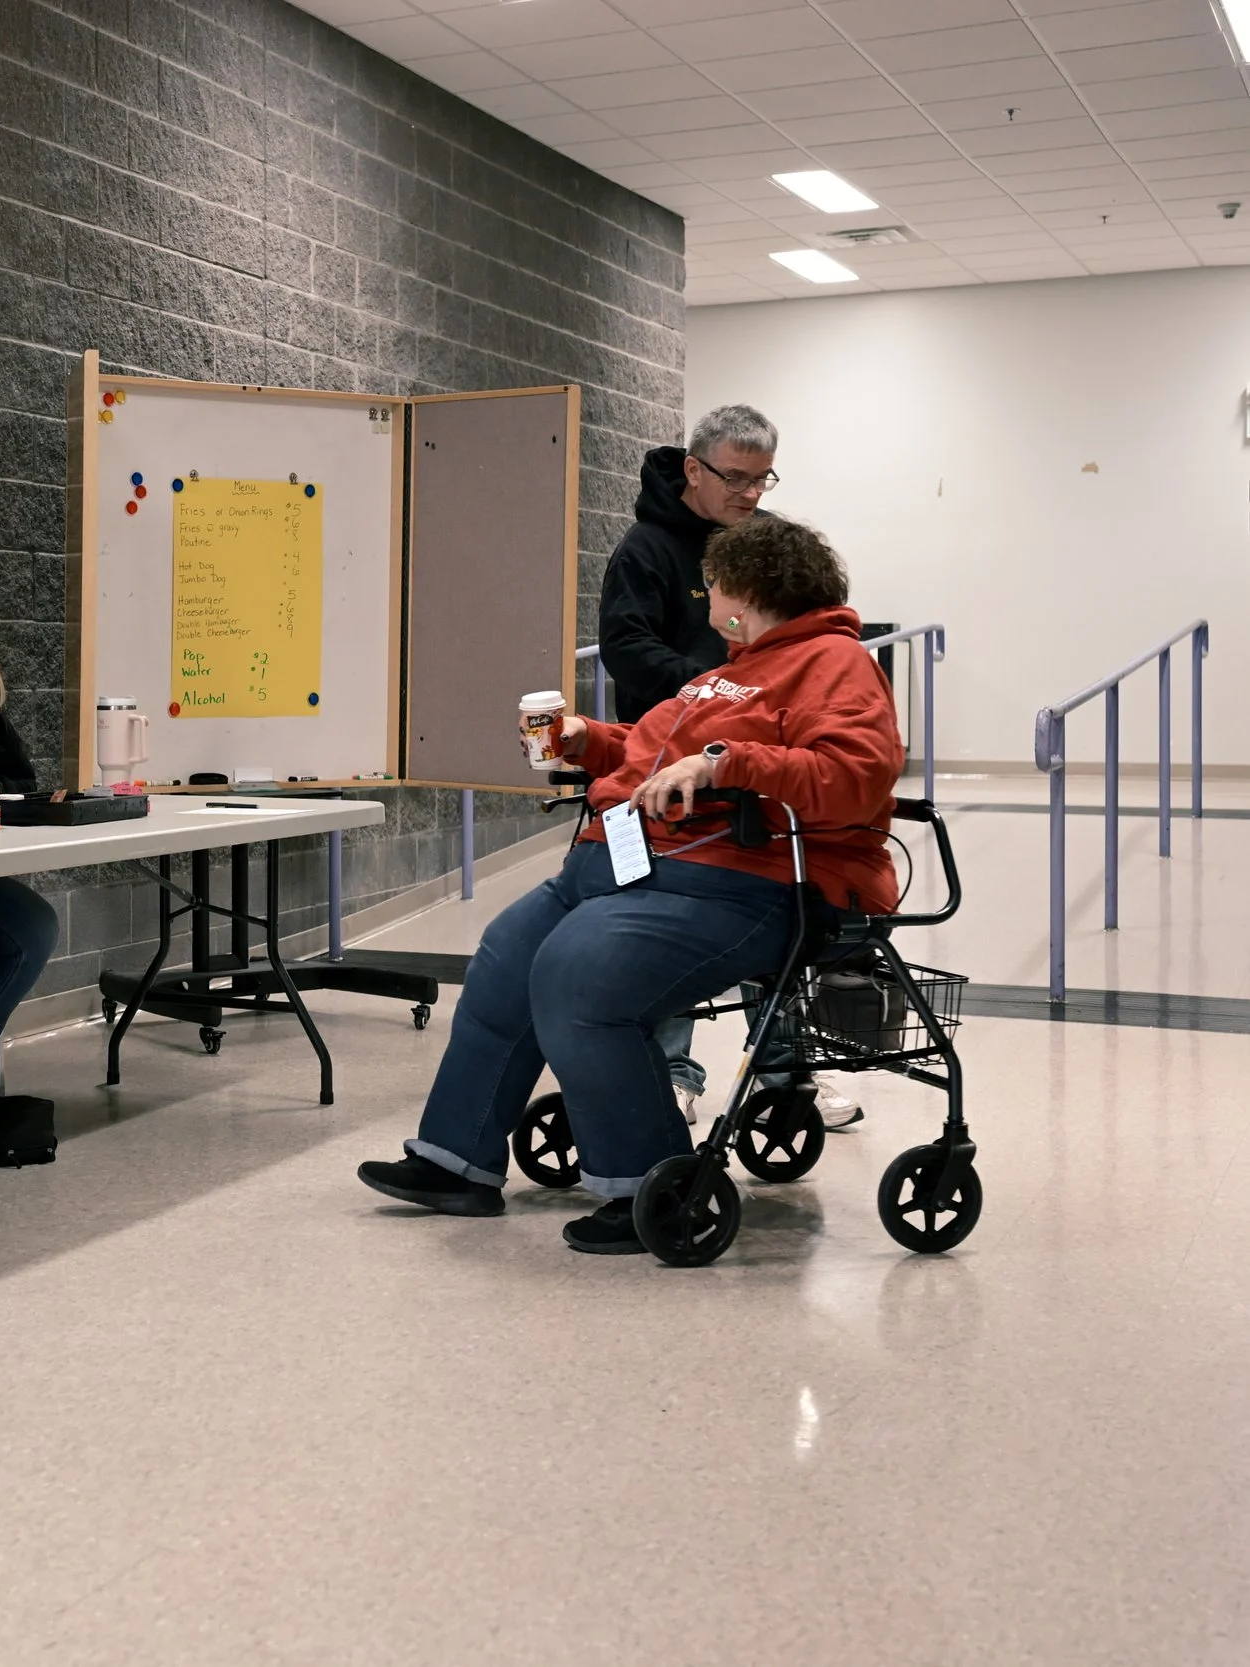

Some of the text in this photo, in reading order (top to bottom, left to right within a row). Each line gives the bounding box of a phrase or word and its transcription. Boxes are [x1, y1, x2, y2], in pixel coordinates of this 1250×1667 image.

[234, 480, 257, 493] Menu
[180, 503, 206, 517] Fries
[229, 507, 250, 517] Onion
[251, 506, 274, 521] Rings
[179, 522, 201, 534] Fries
[219, 524, 240, 537] gravy
[180, 537, 212, 548] Poutine
[178, 561, 192, 571] Hot
[199, 561, 215, 575] Dog
[178, 574, 206, 584] Jumbo
[212, 573, 226, 588] Dog
[178, 595, 224, 609] Hamburger
[177, 608, 230, 620] Cheeseburger
[177, 618, 201, 630] Double
[176, 629, 202, 640] Double
[183, 649, 205, 664] Pop
[181, 665, 211, 678] Water
[181, 690, 226, 707] Alcohol
